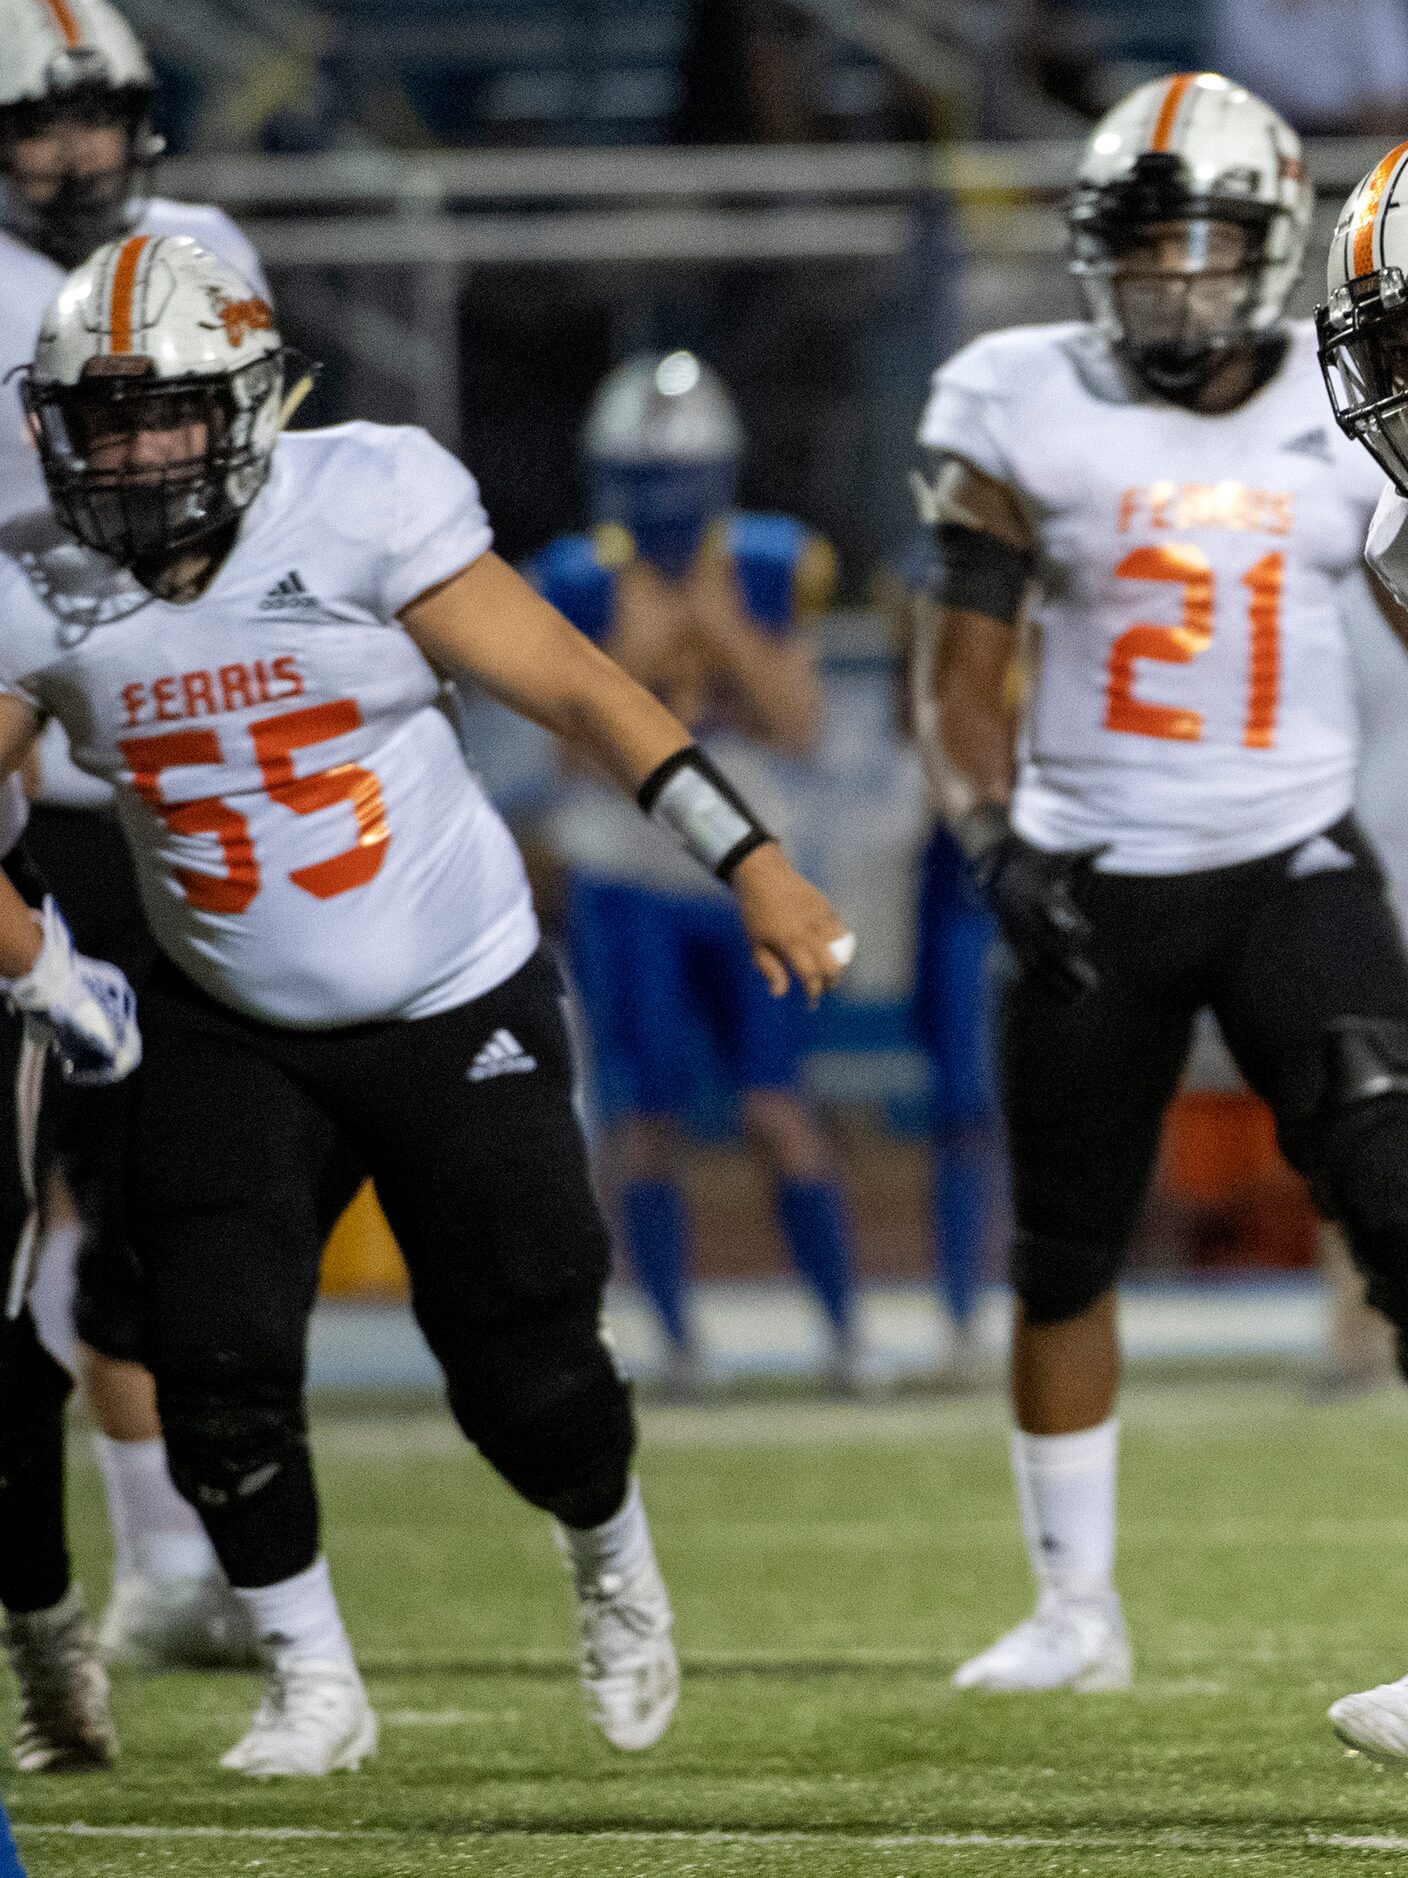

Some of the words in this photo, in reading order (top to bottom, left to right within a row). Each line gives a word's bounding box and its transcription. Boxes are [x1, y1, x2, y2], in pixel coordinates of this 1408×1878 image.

[121, 656, 304, 727] FERRIS
[1105, 544, 1284, 748] 21
[118, 698, 390, 913] 55
